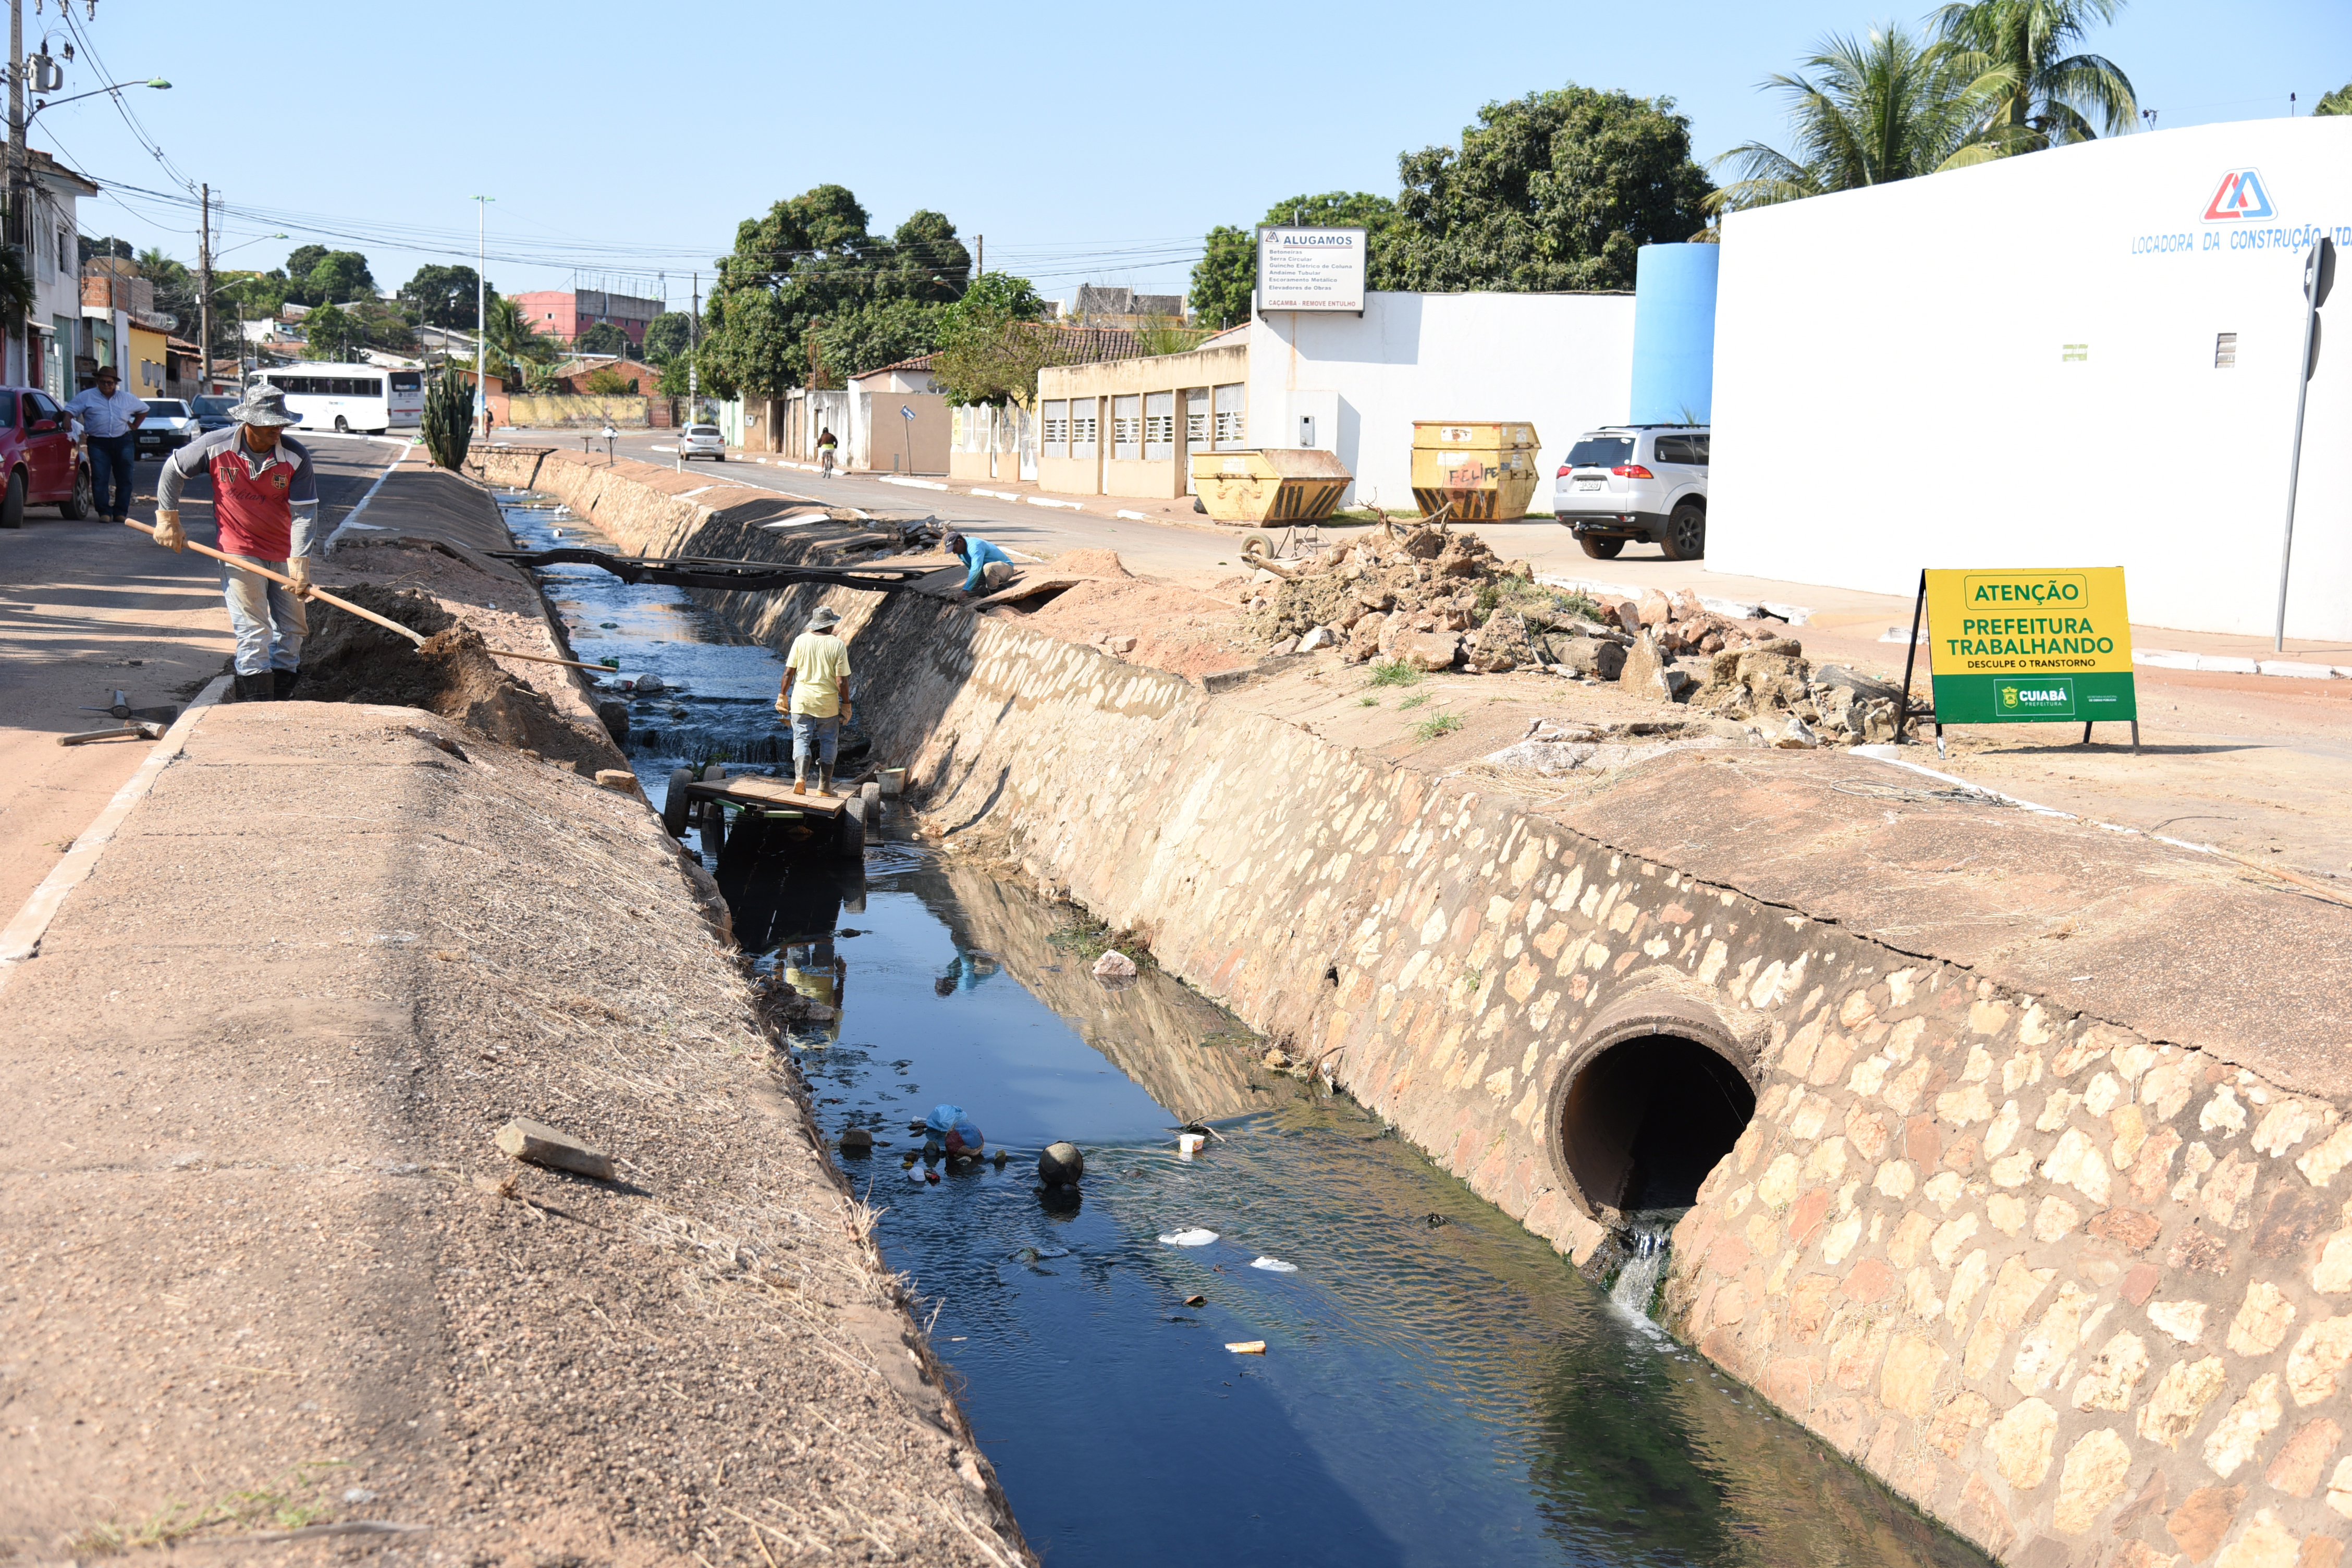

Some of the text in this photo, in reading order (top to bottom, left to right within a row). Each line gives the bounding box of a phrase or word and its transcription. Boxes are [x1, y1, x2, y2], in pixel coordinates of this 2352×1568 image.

[1283, 236, 1352, 245] ALUGAMOS
[2132, 232, 2193, 254] LOCADORA
[2202, 231, 2220, 250] DA
[2329, 226, 2352, 246] LTD
[218, 467, 239, 483] IV
[1449, 463, 1499, 485] FELIPE
[1975, 580, 2079, 605] ATENÇÃO
[1963, 618, 2094, 635] PREFEITURA
[1946, 637, 2114, 656] TRABALHANDO
[1967, 659, 2096, 668] DESCULPE O TRANSTORNO
[2019, 687, 2067, 701] CUIABÁ
